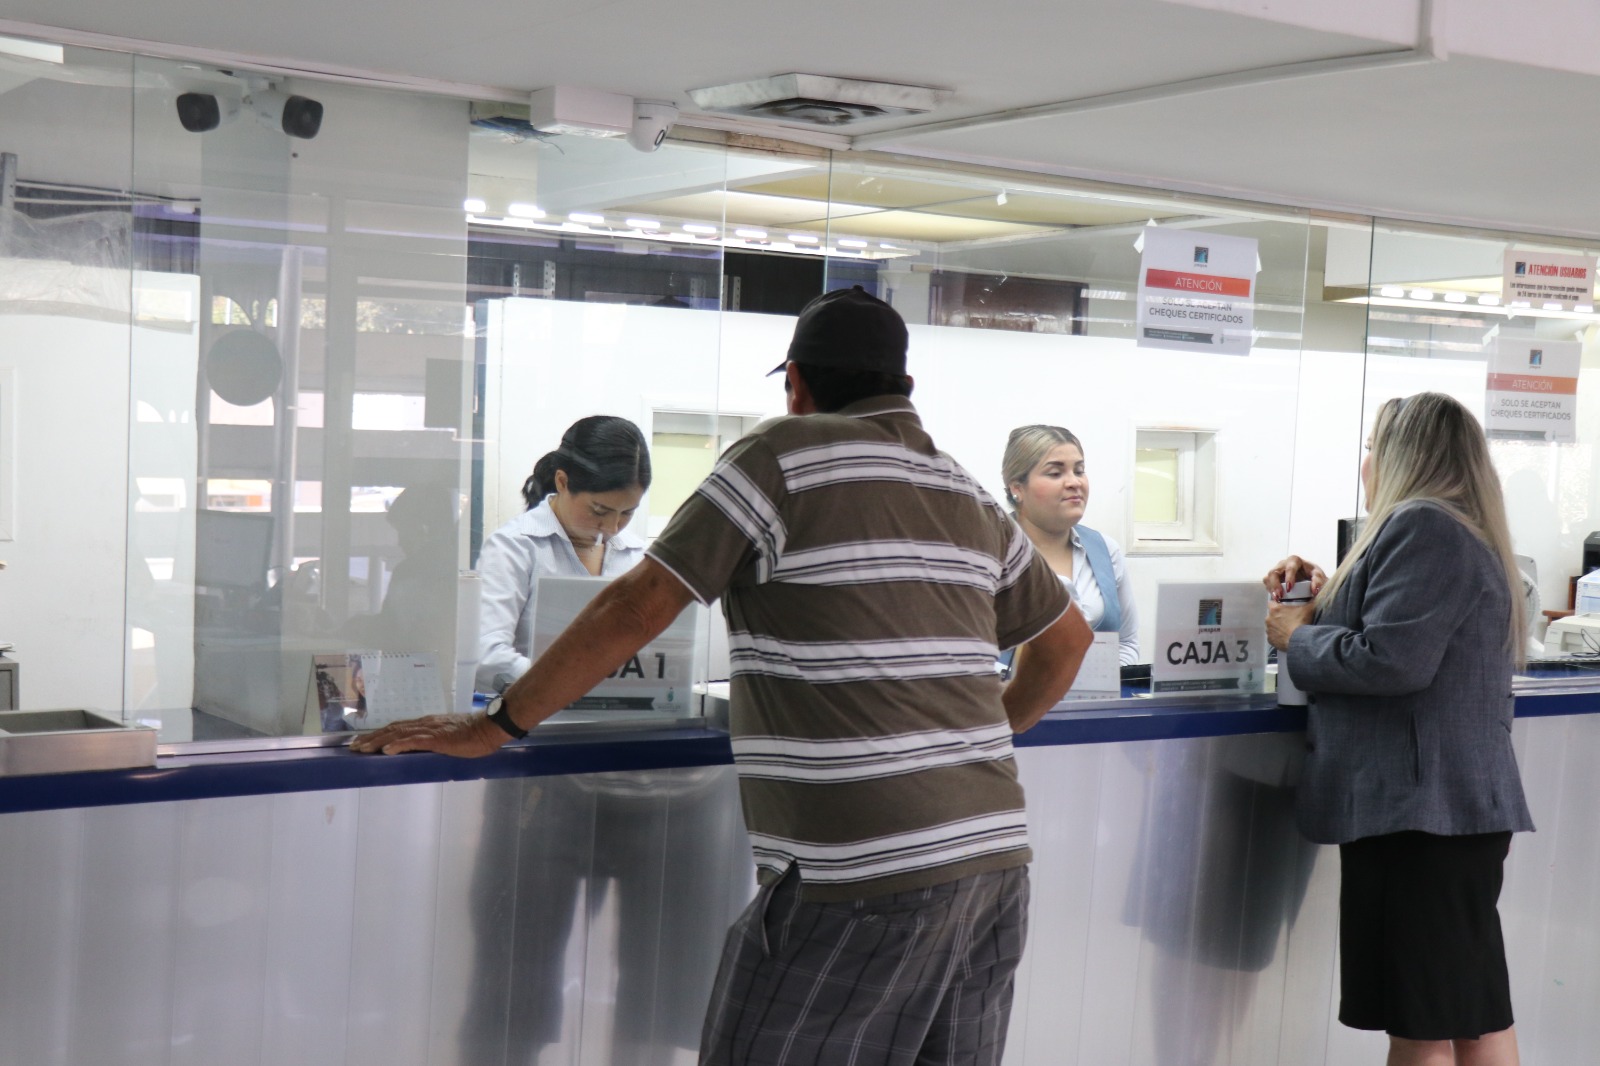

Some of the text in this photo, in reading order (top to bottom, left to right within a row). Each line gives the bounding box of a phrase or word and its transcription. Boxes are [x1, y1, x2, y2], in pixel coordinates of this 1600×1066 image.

[1528, 264, 1587, 279] ATENCIÓN USUARIOS
[1175, 277, 1223, 291] ATENCIÓN
[1149, 307, 1243, 324] CHEQUES CERTIFICADOS
[1512, 379, 1552, 390] ATENCIÓN
[1501, 399, 1561, 409] SOLO SE ACEPTAN
[1491, 409, 1571, 420] CHEQUES CERTIFICADOS
[1167, 640, 1249, 665] CAJA 3
[655, 652, 666, 679] 1
